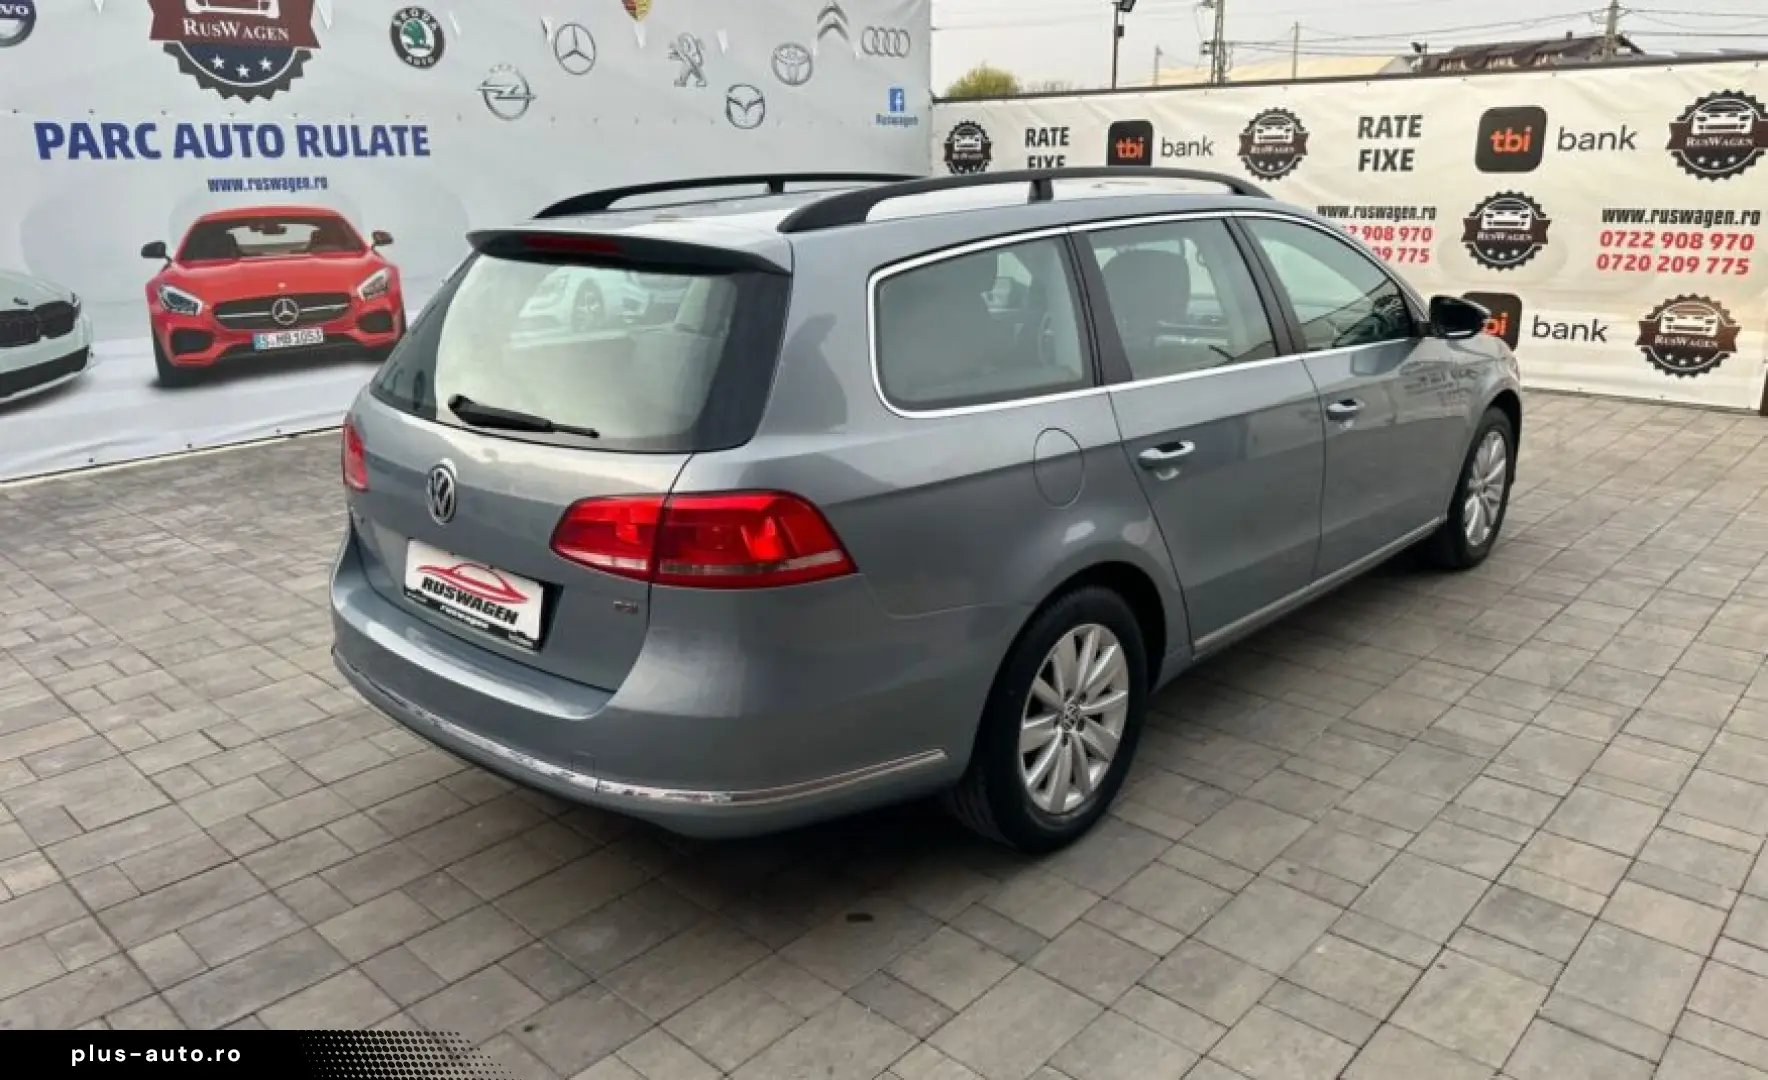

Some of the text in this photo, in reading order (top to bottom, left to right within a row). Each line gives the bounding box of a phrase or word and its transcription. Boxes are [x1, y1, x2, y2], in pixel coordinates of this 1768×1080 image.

[1025, 126, 1070, 147] RATE
[1357, 114, 1423, 139] RATE
[34, 121, 431, 160] PARC AUTO RULATE
[1115, 136, 1214, 159] tbi bank
[1490, 124, 1638, 153] tbi bank
[1358, 149, 1415, 172] FIXE
[207, 176, 328, 193] www.ruswagen.ro
[1317, 205, 1437, 222] www.ruswagen.ro
[1602, 208, 1760, 228] www.ruswagen.ro
[1362, 226, 1395, 241] 908
[1400, 227, 1432, 243] 970
[1600, 230, 1755, 251] 0722 908 970
[1397, 247, 1430, 263] 775
[1596, 253, 1749, 276] 0720 209 775
[1532, 314, 1609, 343] bank
[422, 575, 519, 625] RUSWAGEN
